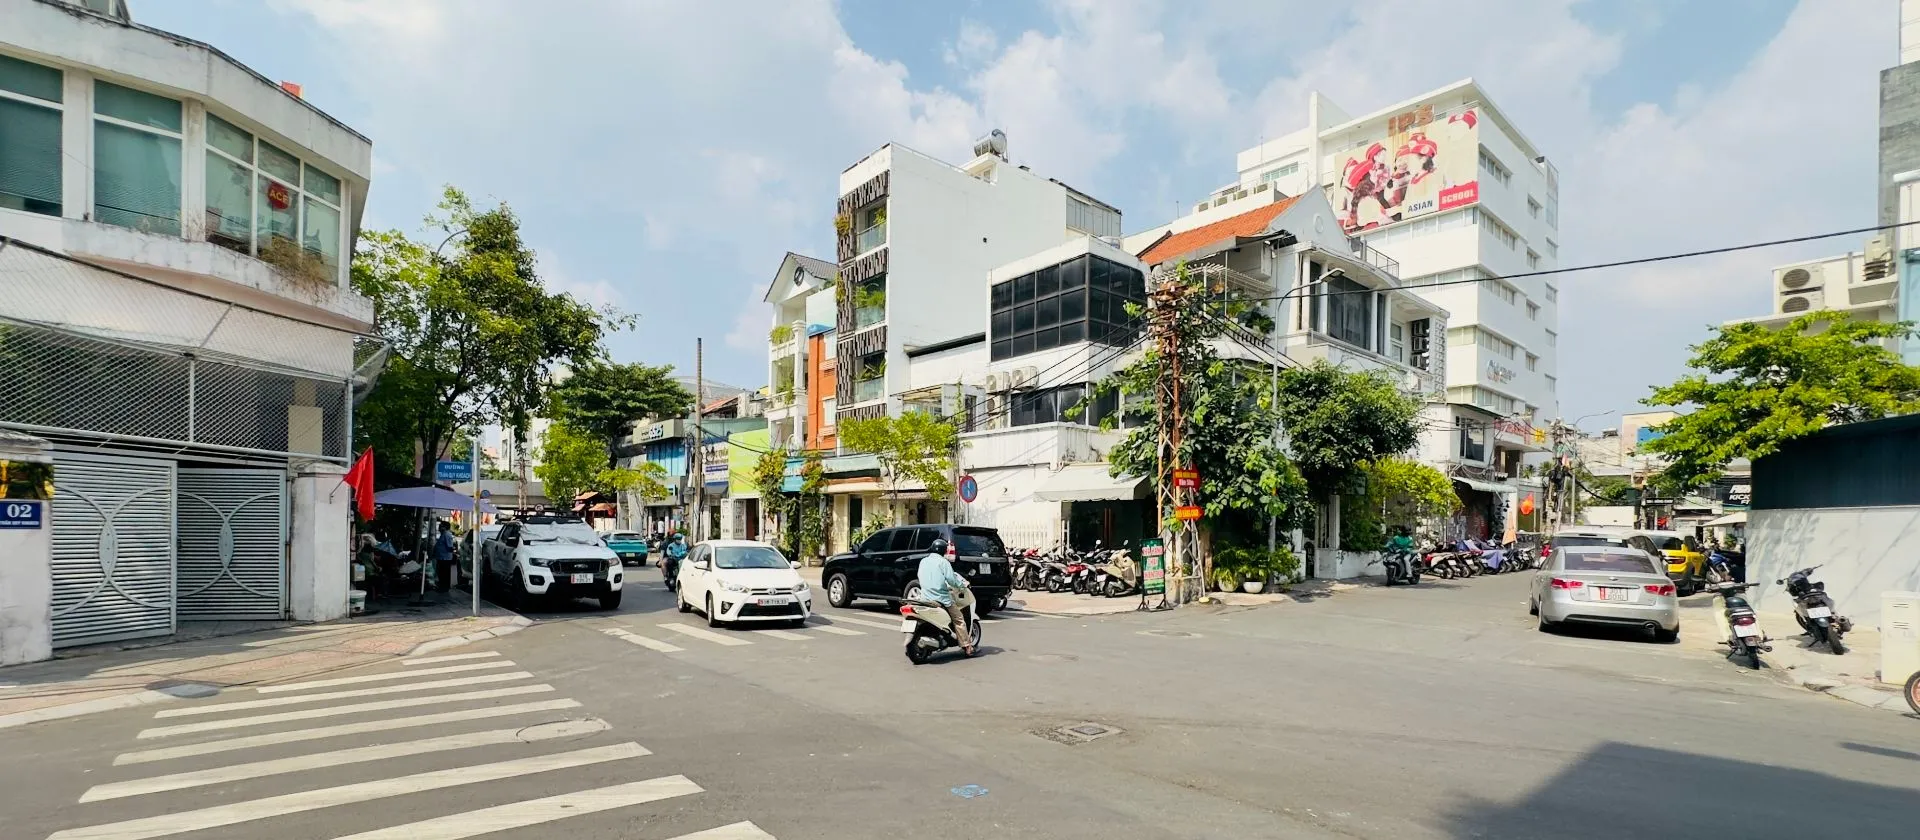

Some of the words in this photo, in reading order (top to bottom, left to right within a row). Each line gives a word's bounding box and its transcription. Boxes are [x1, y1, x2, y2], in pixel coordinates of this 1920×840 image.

[1407, 199, 1433, 213] ASIAN
[1441, 189, 1475, 204] SCHOOL
[7, 503, 32, 518] 02
